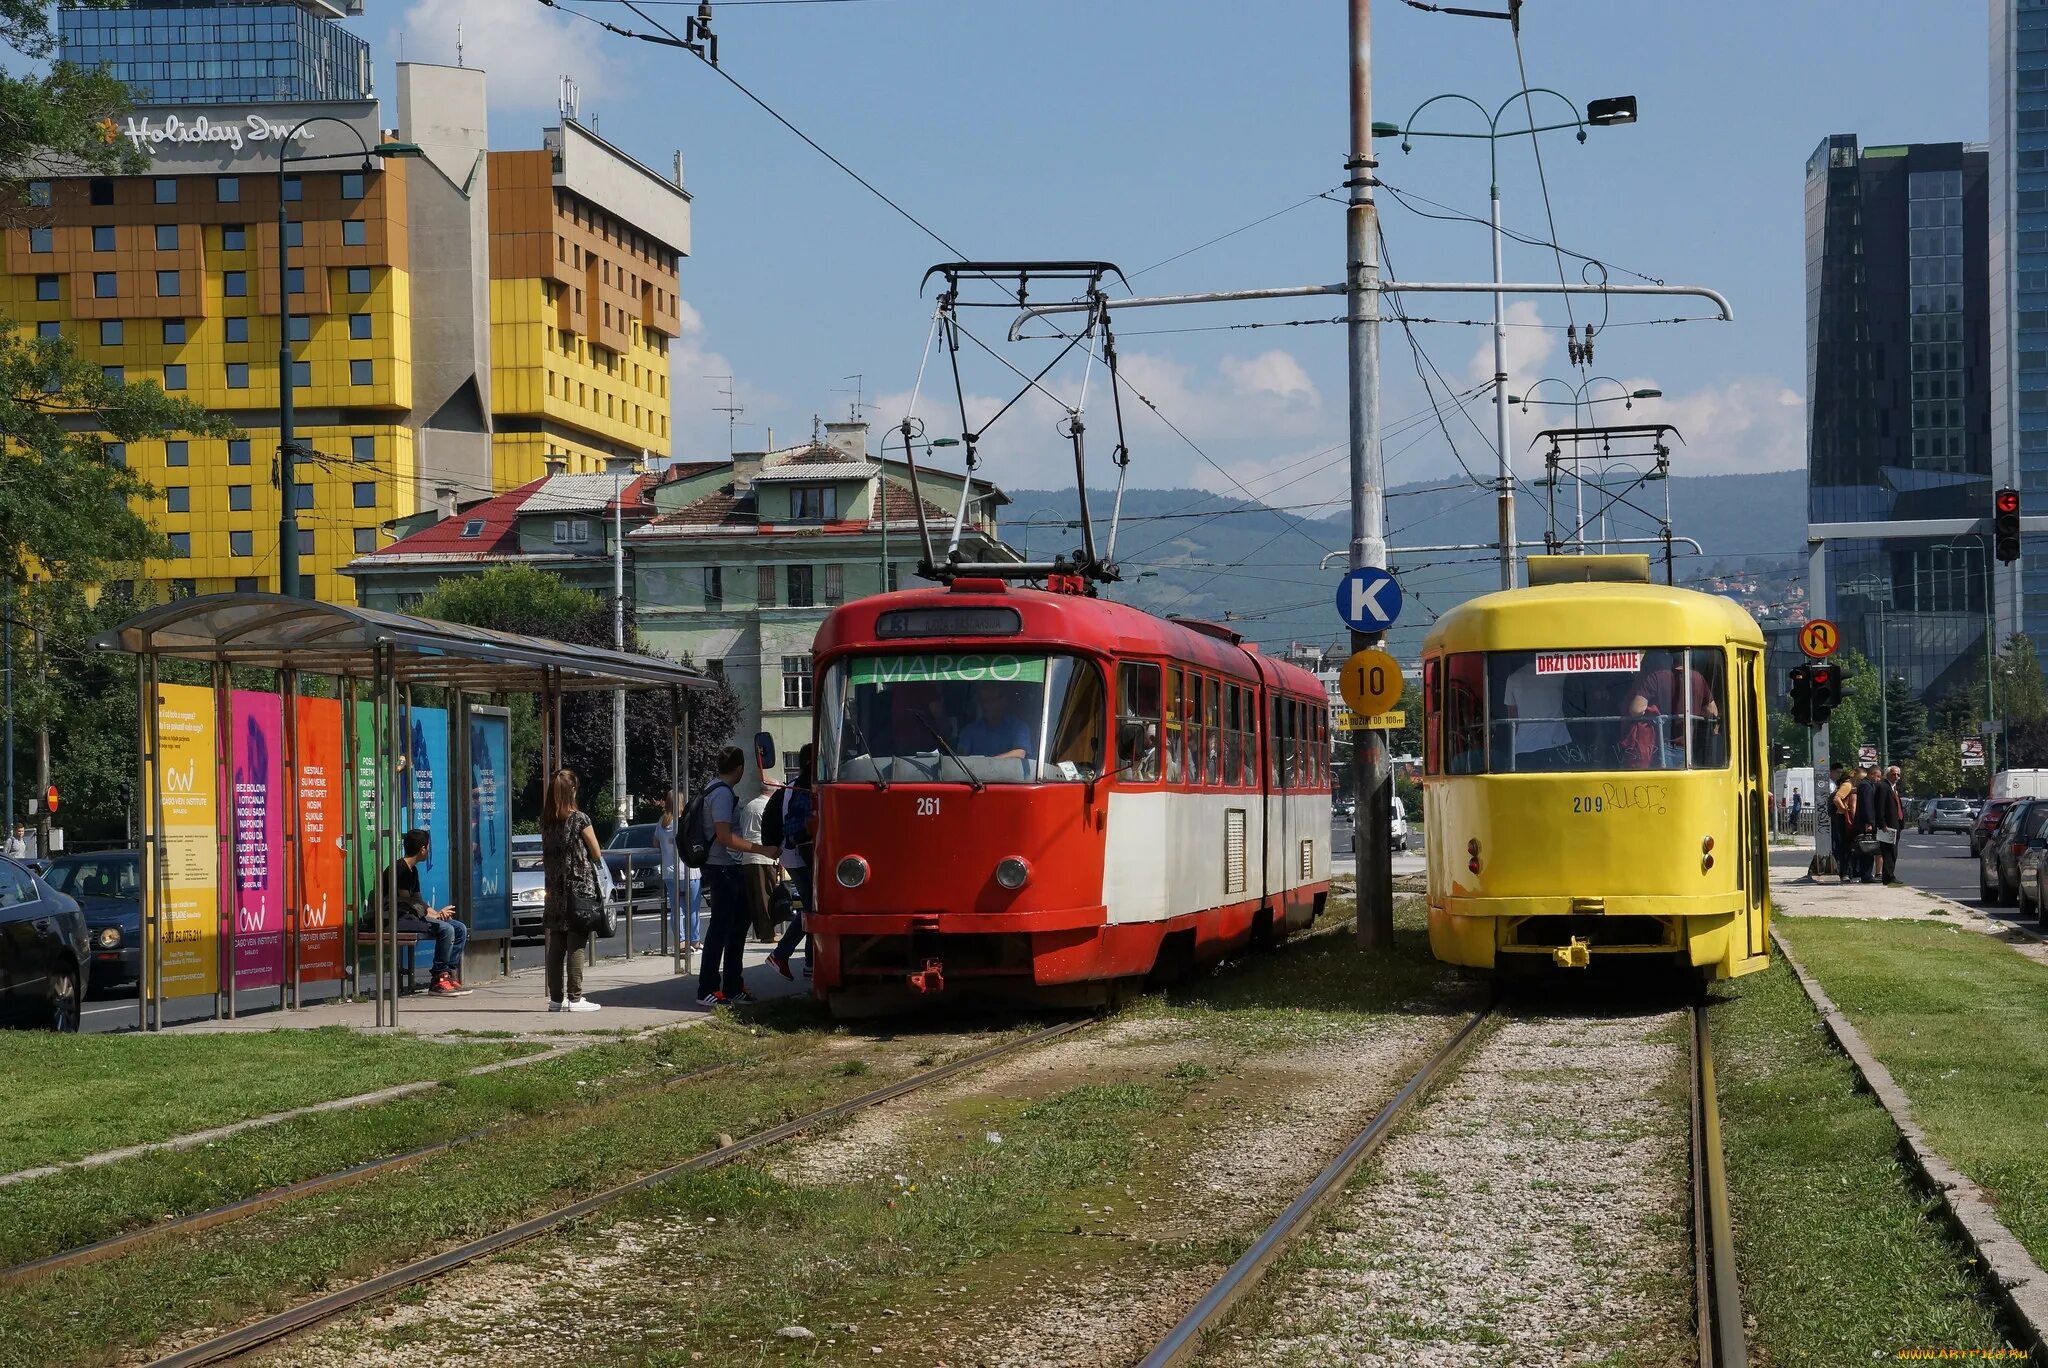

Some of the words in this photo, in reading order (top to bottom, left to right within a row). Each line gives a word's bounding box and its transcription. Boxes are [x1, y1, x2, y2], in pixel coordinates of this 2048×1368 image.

[124, 114, 243, 154] Holiday
[246, 114, 315, 141] Inn
[1350, 578, 1390, 621] K
[1538, 654, 1564, 672] DRŽI
[1567, 652, 1638, 671] ODSTOJANJE
[872, 654, 1021, 683] MARGO
[1357, 666, 1385, 696] 10
[1340, 718, 1349, 726] NA
[1373, 716, 1382, 725] OD
[304, 766, 324, 775] NESTALE
[314, 778, 327, 786] VENE
[236, 784, 246, 792] BEZ
[247, 784, 266, 792] BOLOVA
[315, 790, 328, 798] OPET
[362, 790, 371, 798] SAD
[242, 796, 265, 804] OTICANJA
[307, 801, 322, 809] NOSIM
[917, 797, 940, 816] 261
[1573, 796, 1603, 813] 209
[238, 808, 251, 816] NOGU
[252, 808, 266, 816] SADA
[305, 812, 324, 821] SUKNJE
[240, 820, 264, 828] NAPOKON
[241, 832, 255, 840] MOGU
[256, 832, 264, 840] DA
[236, 844, 254, 852] BUDEM
[239, 856, 249, 864] ONE
[250, 856, 265, 864] SVOJE
